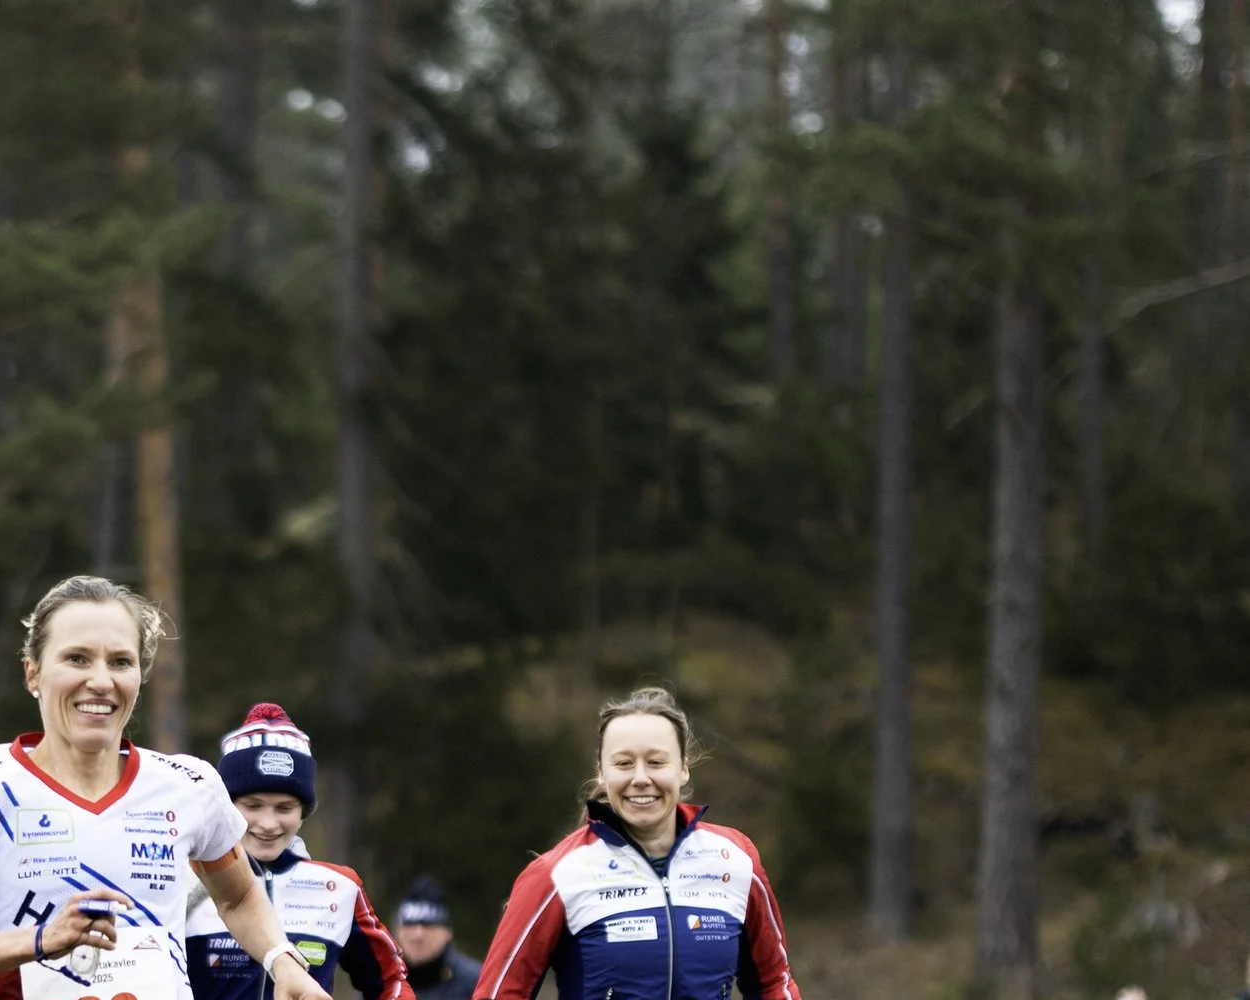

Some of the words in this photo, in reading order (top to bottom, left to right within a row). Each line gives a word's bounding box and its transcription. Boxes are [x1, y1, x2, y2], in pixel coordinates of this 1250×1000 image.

[599, 887, 648, 900] TRIMTEX
[701, 915, 726, 923] RUNES
[222, 954, 250, 962] RUNES
[92, 974, 114, 984] 2025
